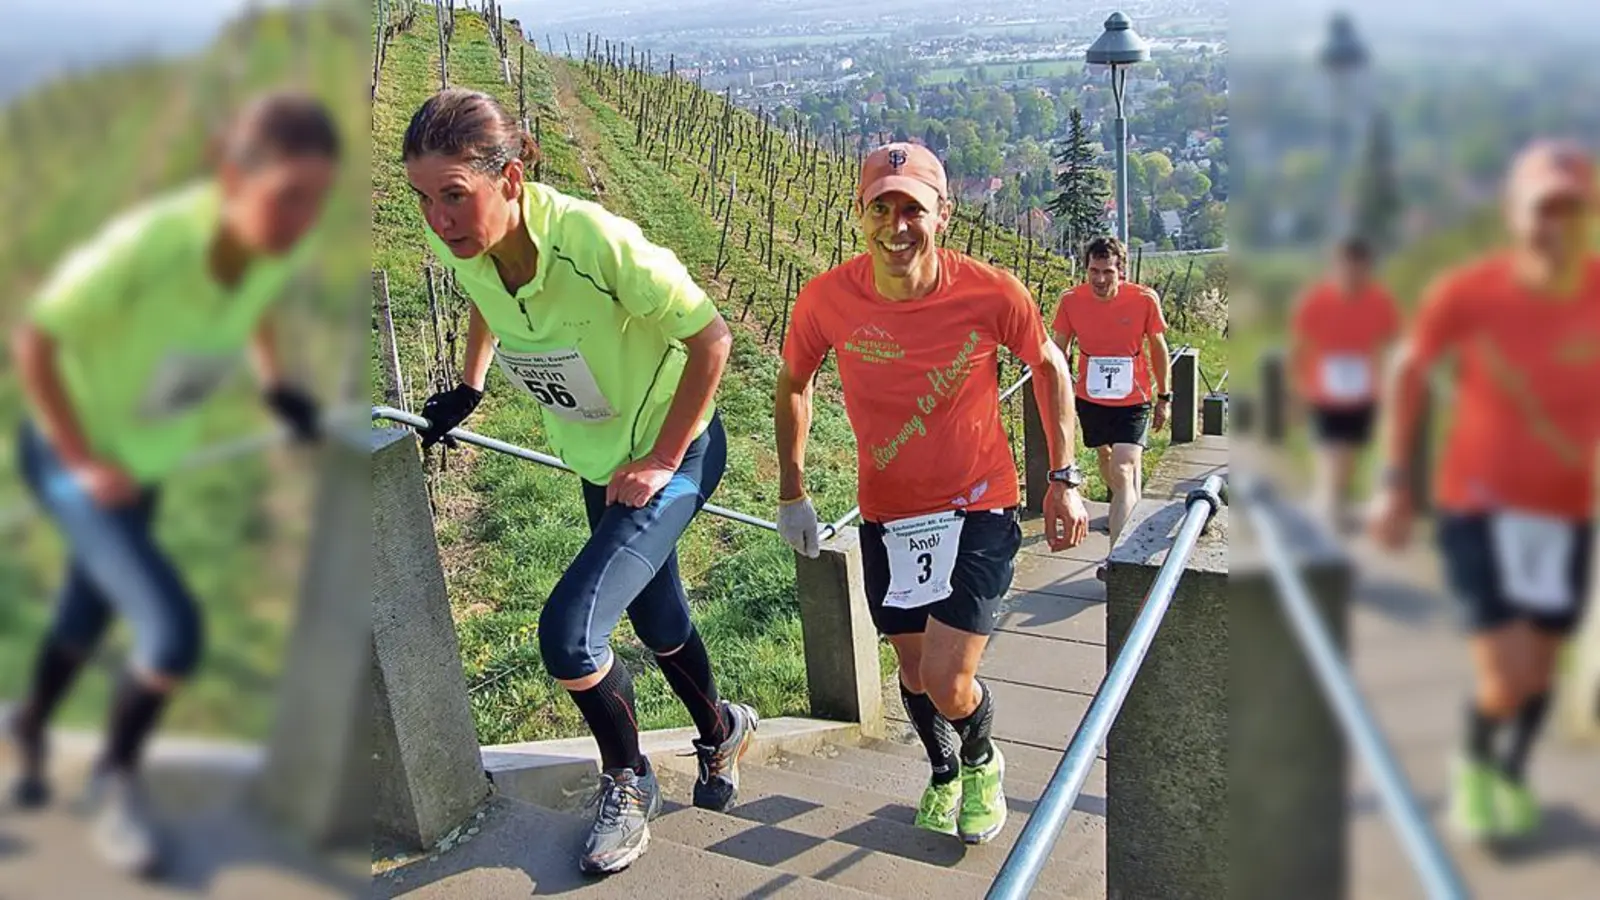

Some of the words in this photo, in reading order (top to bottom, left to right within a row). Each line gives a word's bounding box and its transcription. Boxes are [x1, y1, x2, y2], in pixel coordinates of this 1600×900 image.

[508, 365, 566, 381] Katrin
[926, 330, 981, 397] Heaven
[1099, 364, 1120, 374] Sepp
[1104, 373, 1113, 389] 1
[522, 378, 577, 409] 56
[917, 395, 937, 415] to
[871, 415, 926, 470] Stairway
[909, 533, 940, 551] Andi
[917, 553, 932, 584] 3
